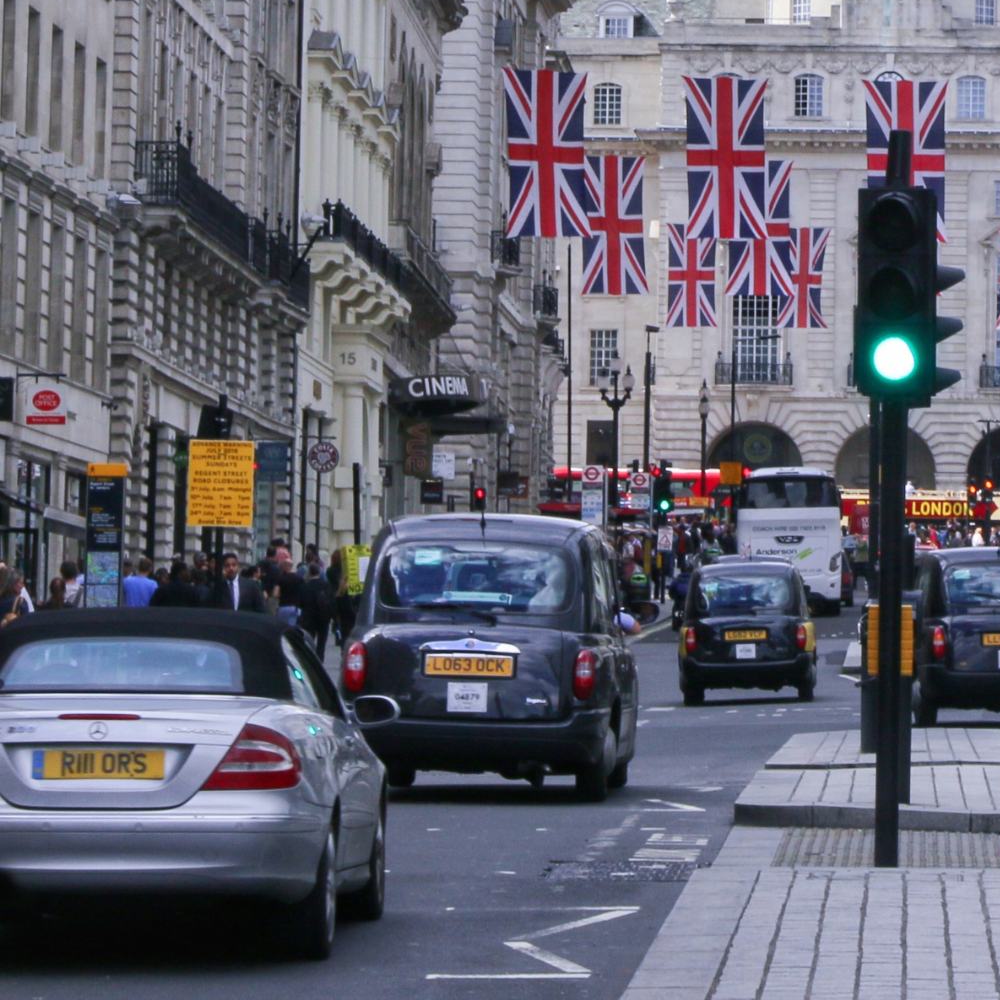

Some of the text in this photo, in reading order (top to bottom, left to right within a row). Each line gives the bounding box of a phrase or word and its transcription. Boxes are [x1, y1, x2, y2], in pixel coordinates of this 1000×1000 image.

[340, 352, 356, 366] 15
[408, 376, 469, 397] CINEMA
[314, 444, 334, 453] COSTA
[311, 459, 336, 470] COFFEE
[912, 502, 974, 516] LONDON
[433, 658, 505, 673] LO63 OCK
